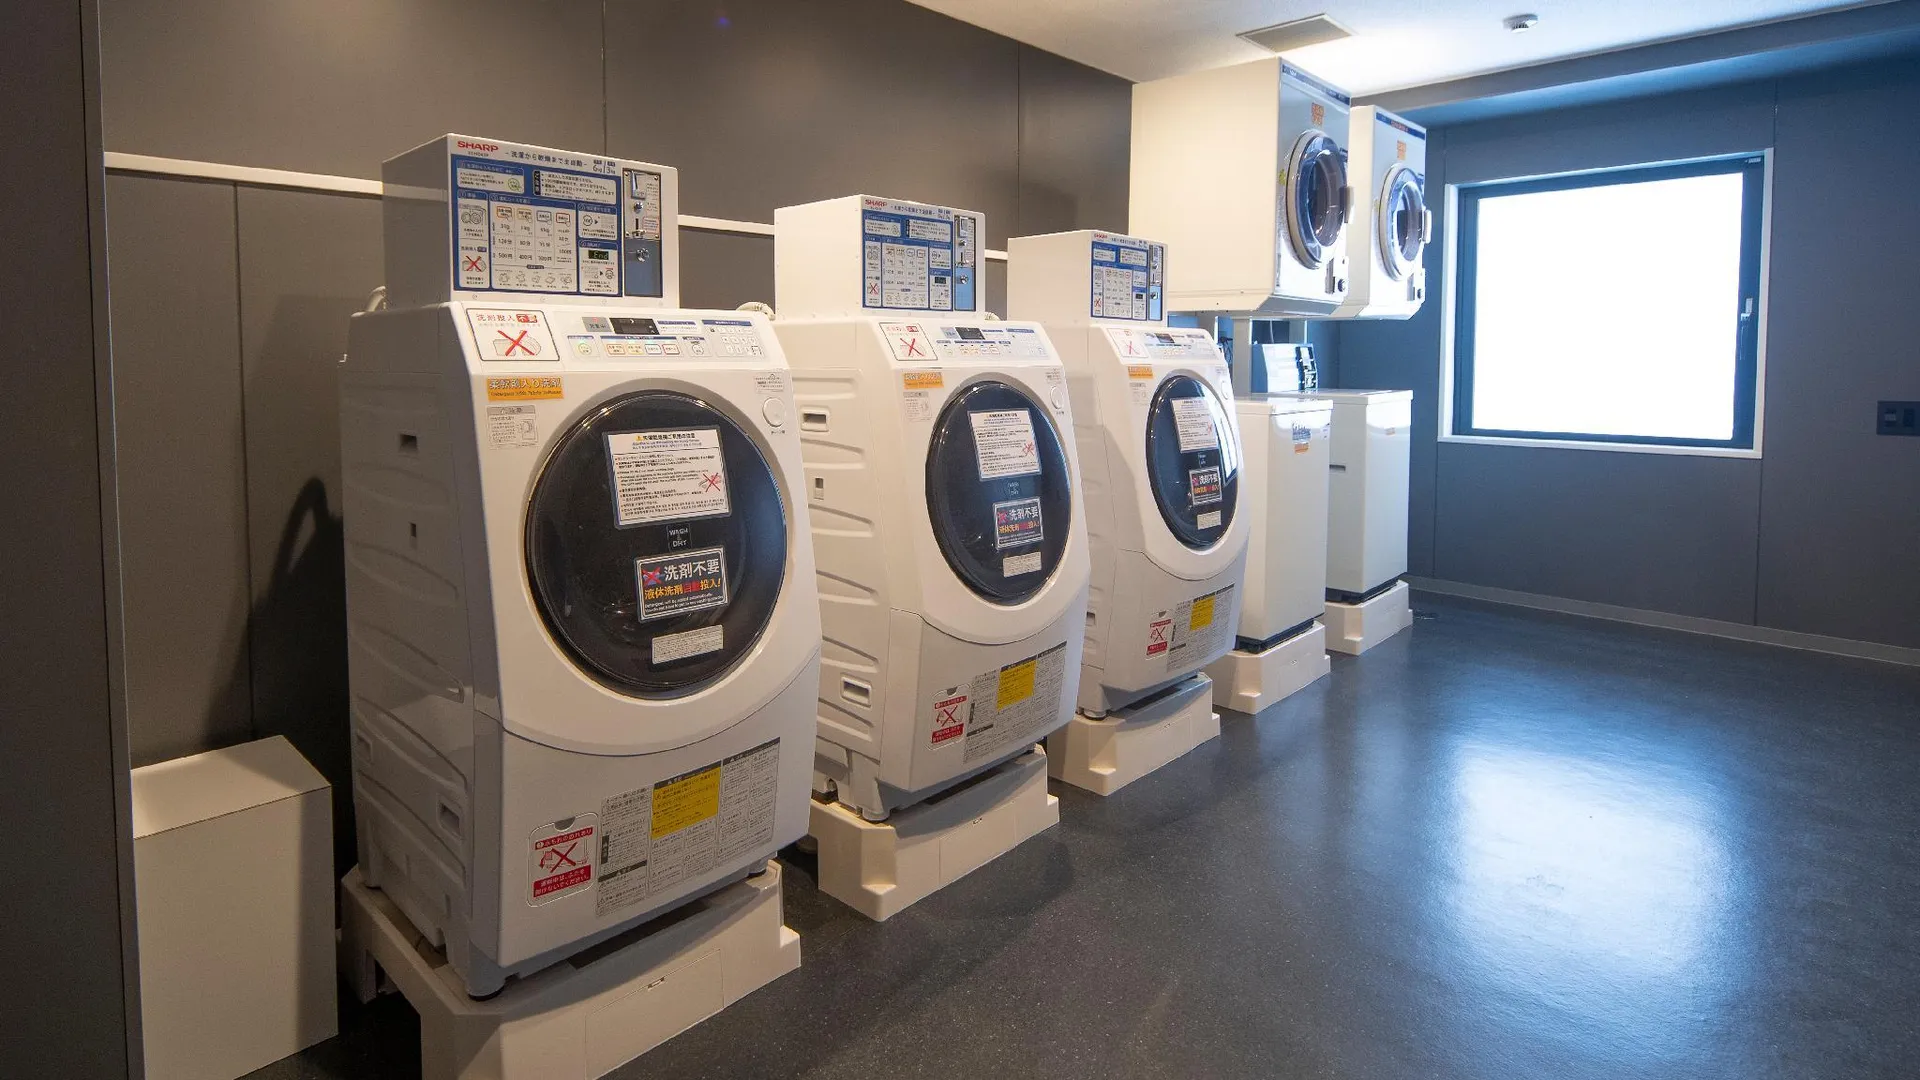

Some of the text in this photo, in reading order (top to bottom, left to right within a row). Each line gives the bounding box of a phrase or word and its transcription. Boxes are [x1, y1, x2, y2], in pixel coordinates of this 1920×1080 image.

[457, 140, 499, 152] SHARP
[865, 199, 887, 207] SHARP
[1009, 506, 1038, 520] 洗剤不要
[669, 527, 688, 536] WASH
[663, 558, 720, 582] 洗剤不要
